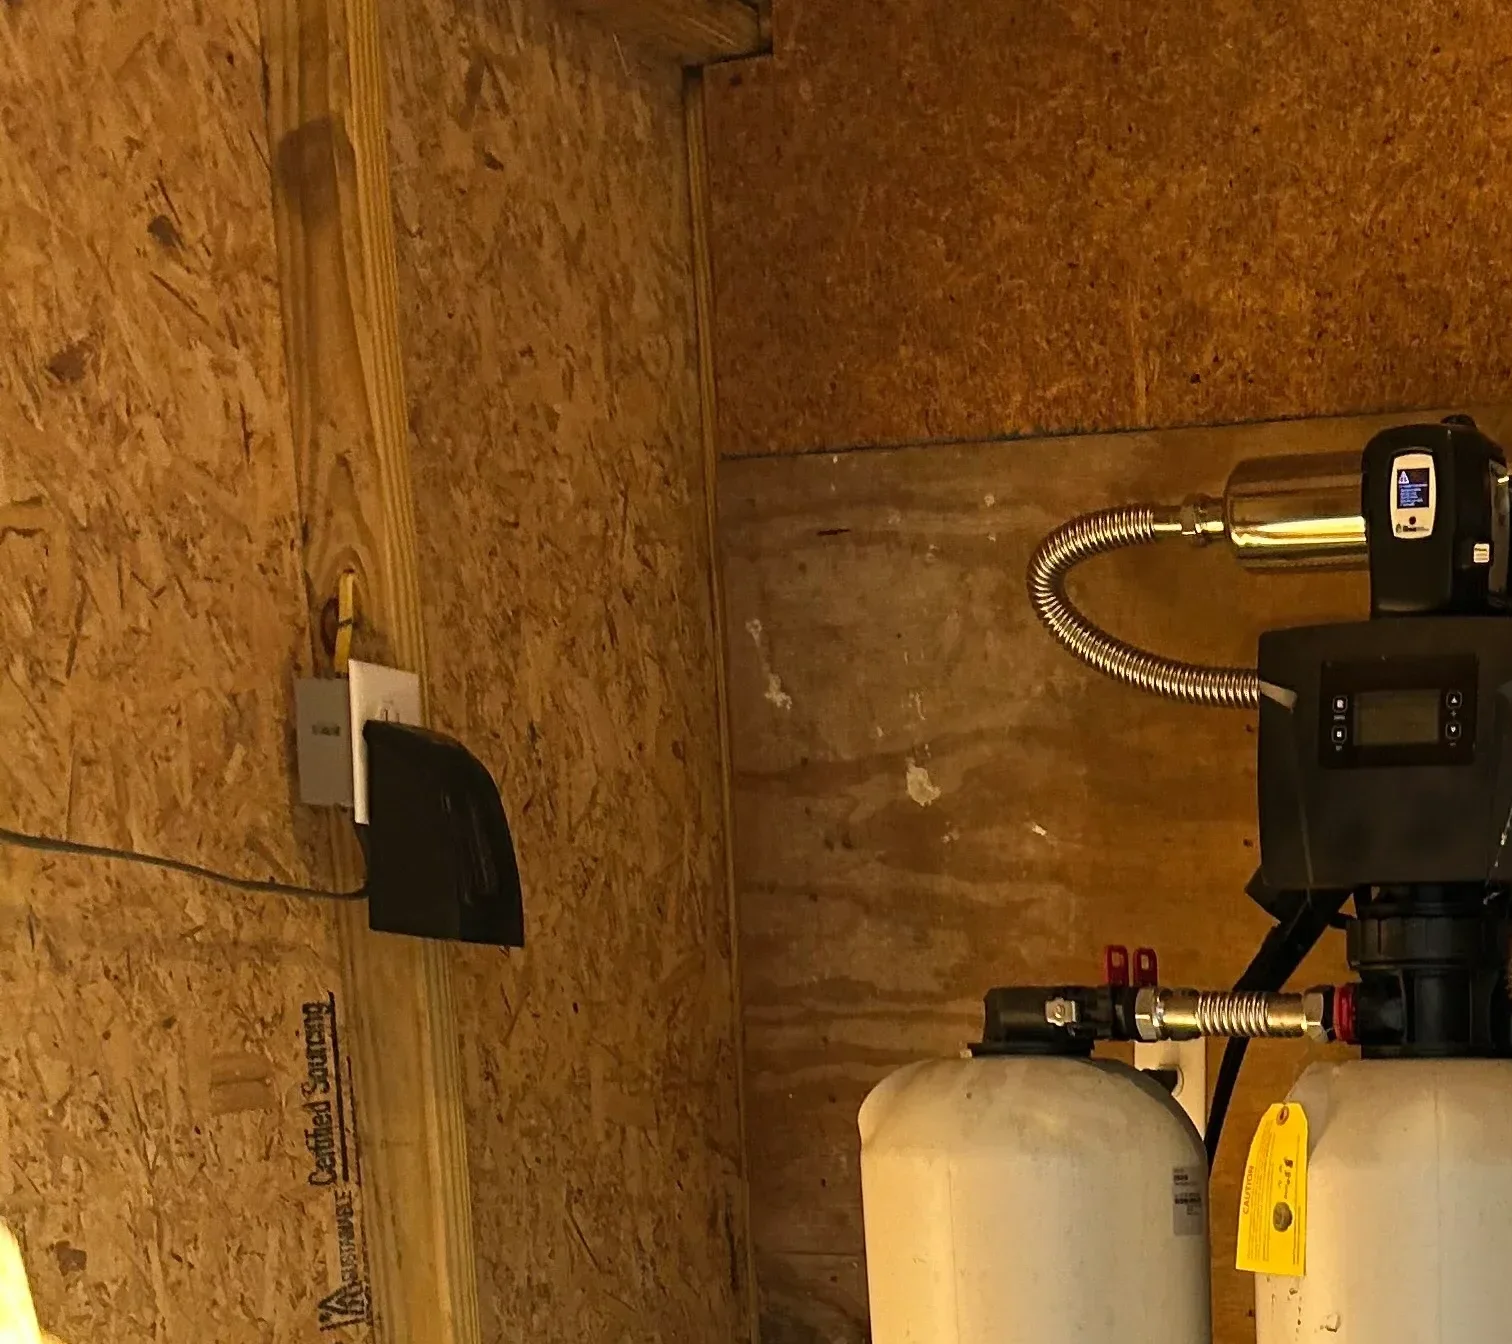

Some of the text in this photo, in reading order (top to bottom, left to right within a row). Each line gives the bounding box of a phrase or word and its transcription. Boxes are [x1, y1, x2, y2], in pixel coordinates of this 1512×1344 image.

[300, 1001, 337, 1187] Certified Sourcing
[1242, 1165, 1255, 1215] CAUTION
